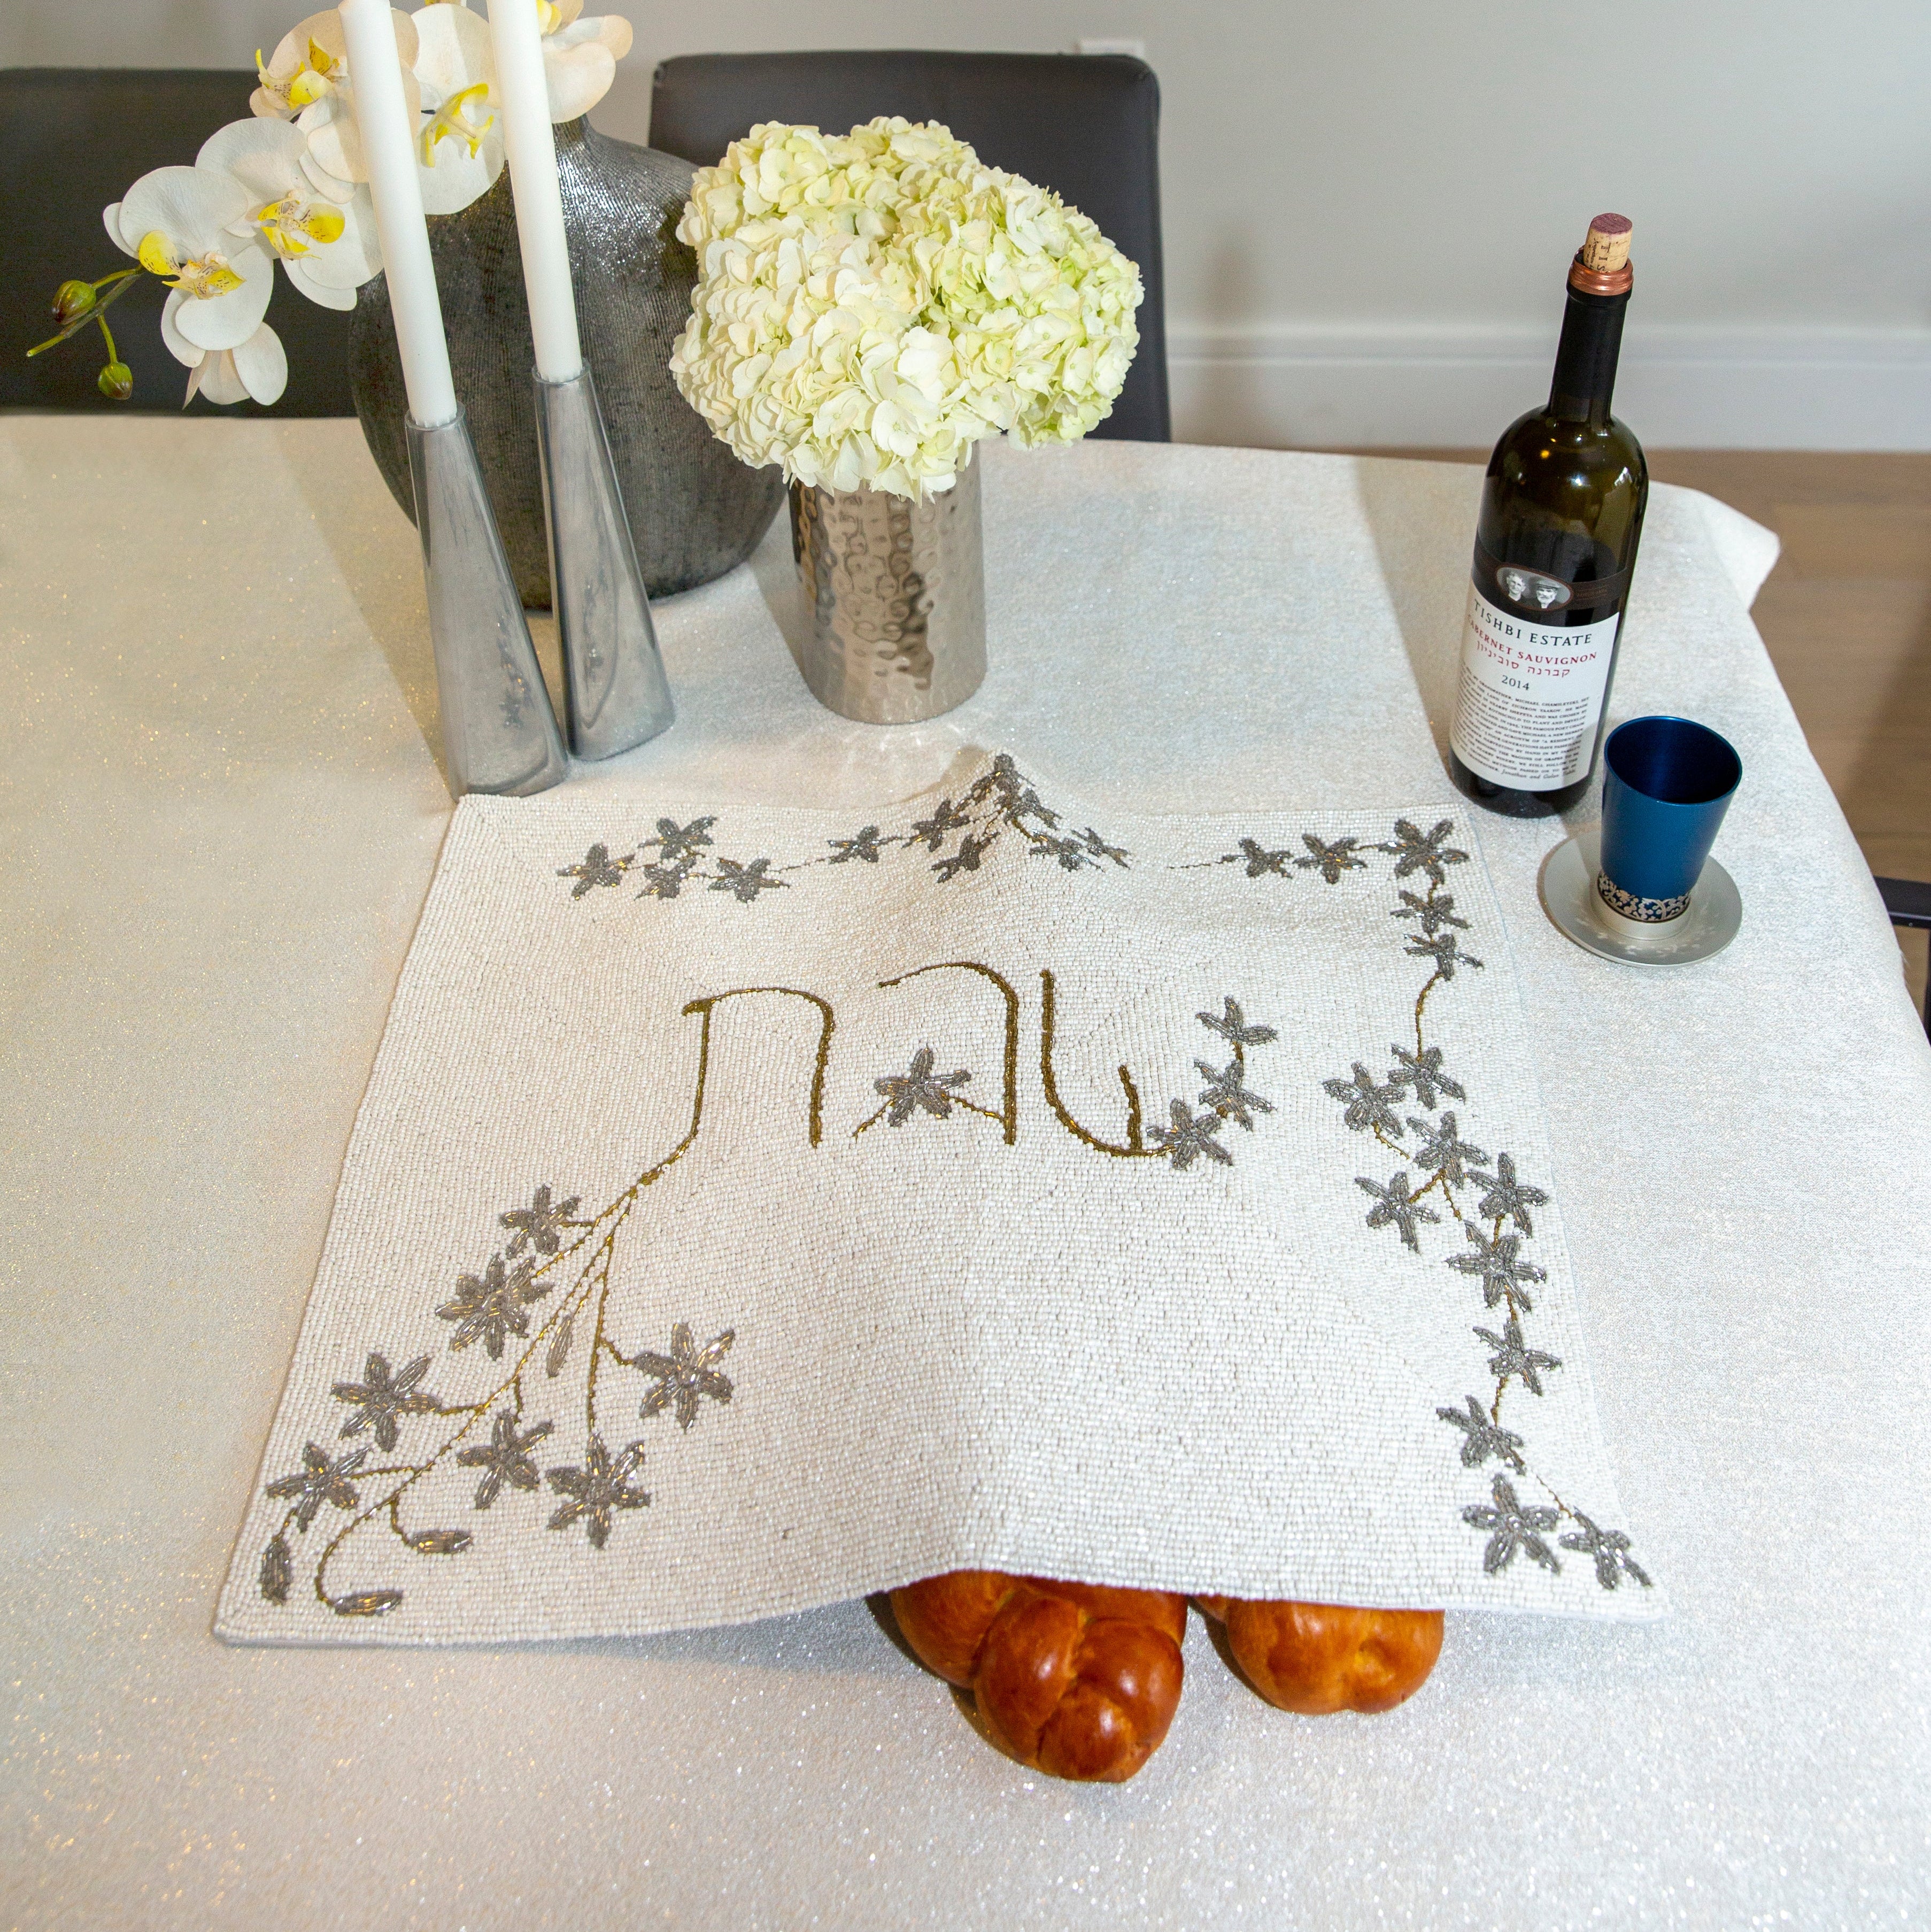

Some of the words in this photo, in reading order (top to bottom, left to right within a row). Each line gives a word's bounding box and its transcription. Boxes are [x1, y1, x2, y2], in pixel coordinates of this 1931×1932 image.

[1474, 598, 1521, 638] TISHBI
[1530, 633, 1592, 646] ESTATE
[1517, 651, 1597, 665] SAUVIGNON
[1527, 666, 1570, 678] קברנה
[1501, 675, 1530, 690] 2014
